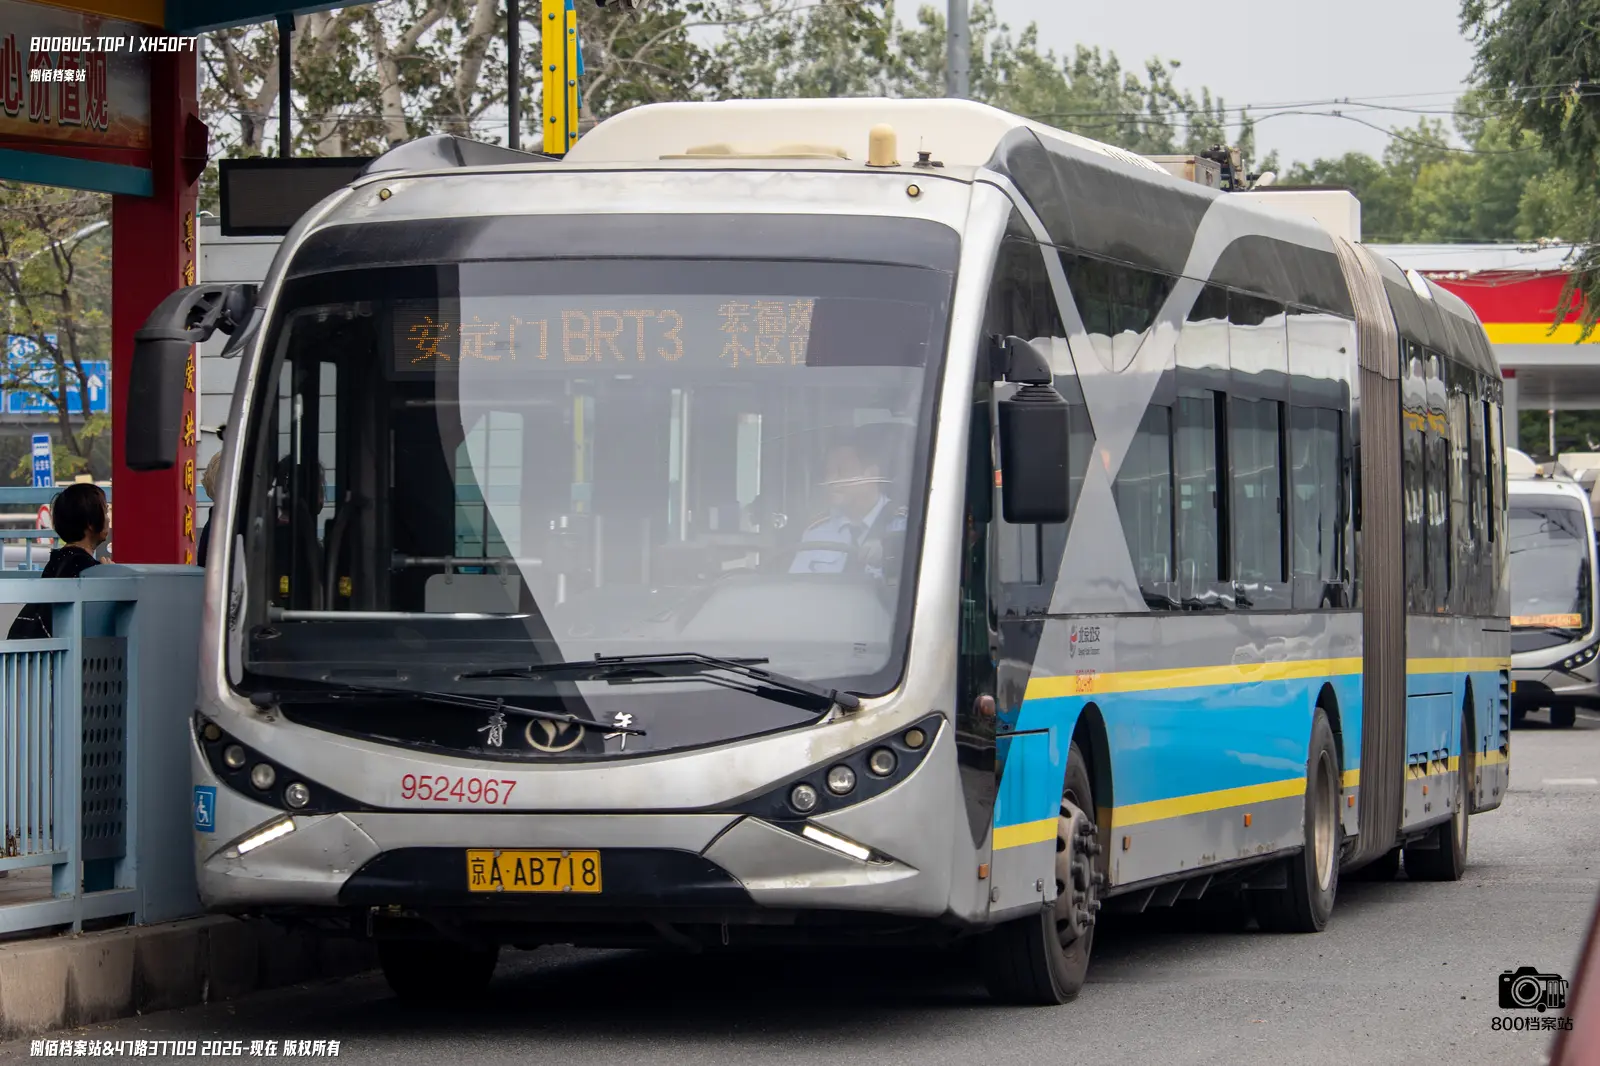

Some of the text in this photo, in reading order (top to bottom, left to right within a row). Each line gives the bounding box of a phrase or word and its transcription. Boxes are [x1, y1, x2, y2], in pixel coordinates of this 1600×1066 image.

[408, 309, 683, 364] 安定门 BRT3
[401, 774, 517, 805] 9524967
